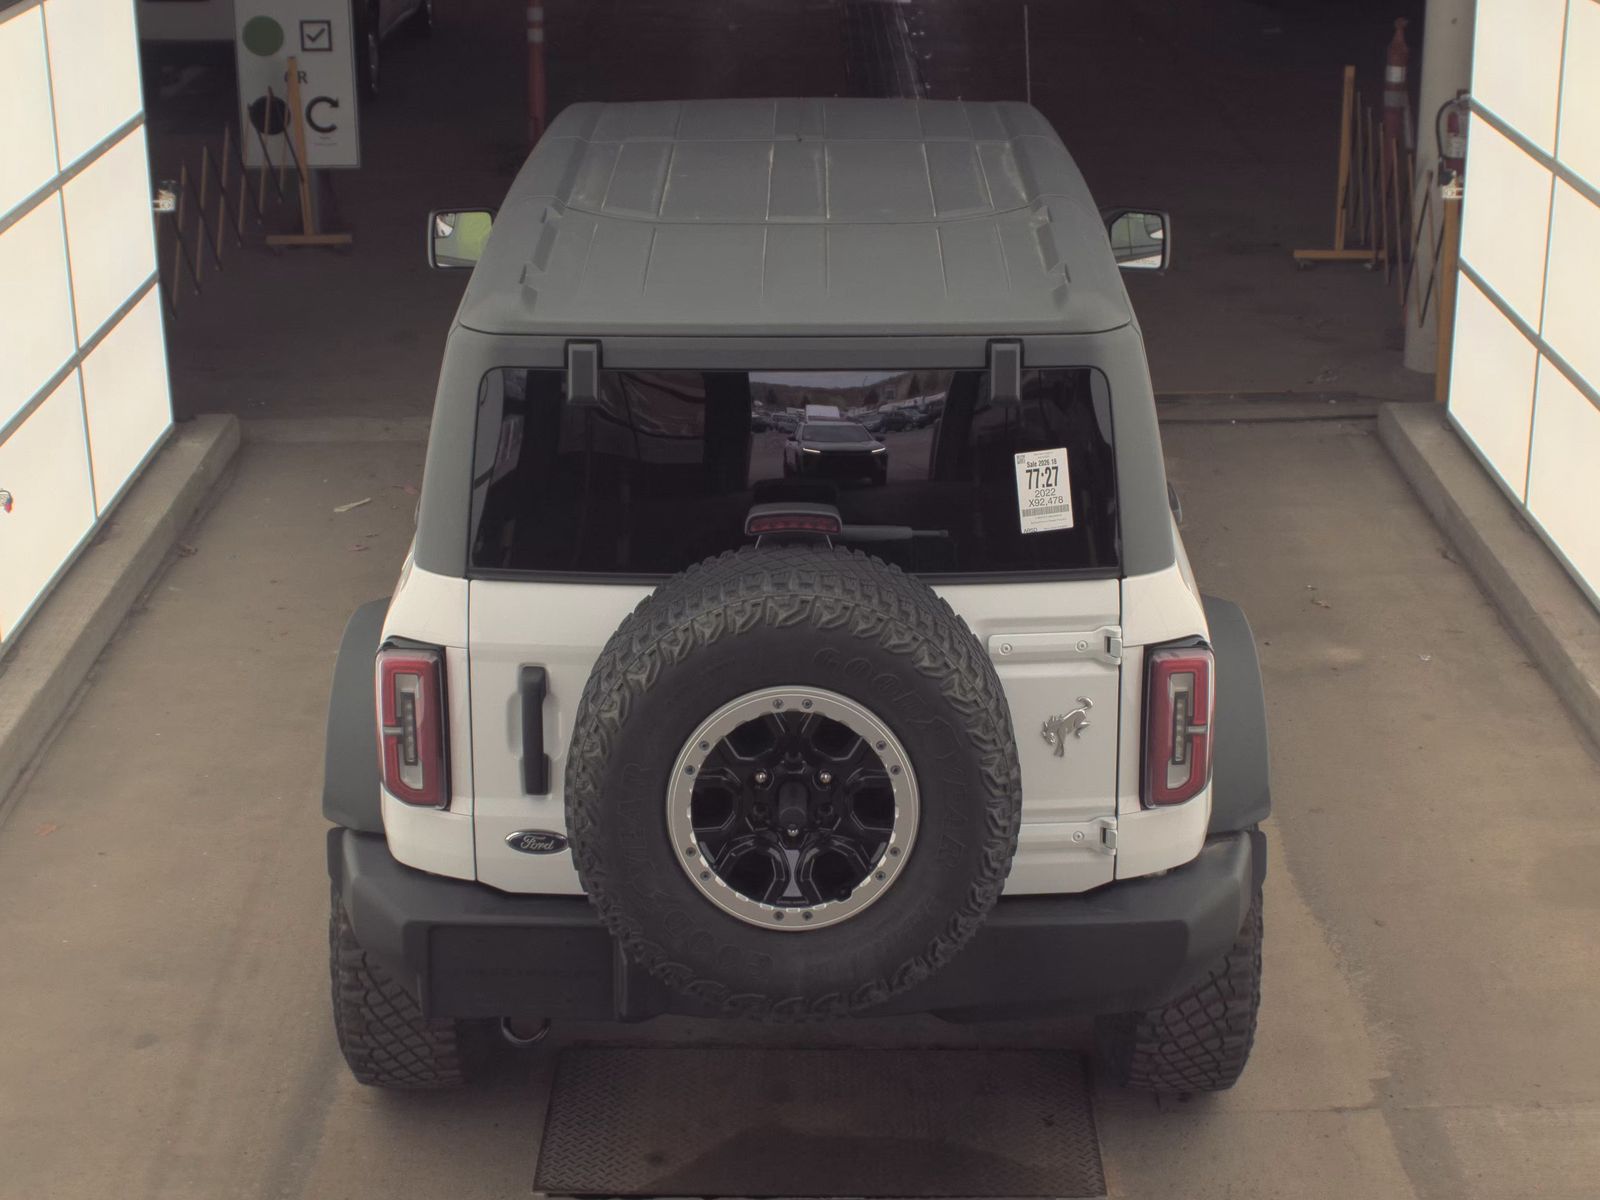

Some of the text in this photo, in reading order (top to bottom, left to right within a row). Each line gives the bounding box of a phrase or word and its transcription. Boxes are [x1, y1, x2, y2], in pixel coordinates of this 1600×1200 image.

[1026, 467, 1058, 489] 77:27
[1035, 488, 1056, 498] 2022
[520, 835, 554, 849] Ford
